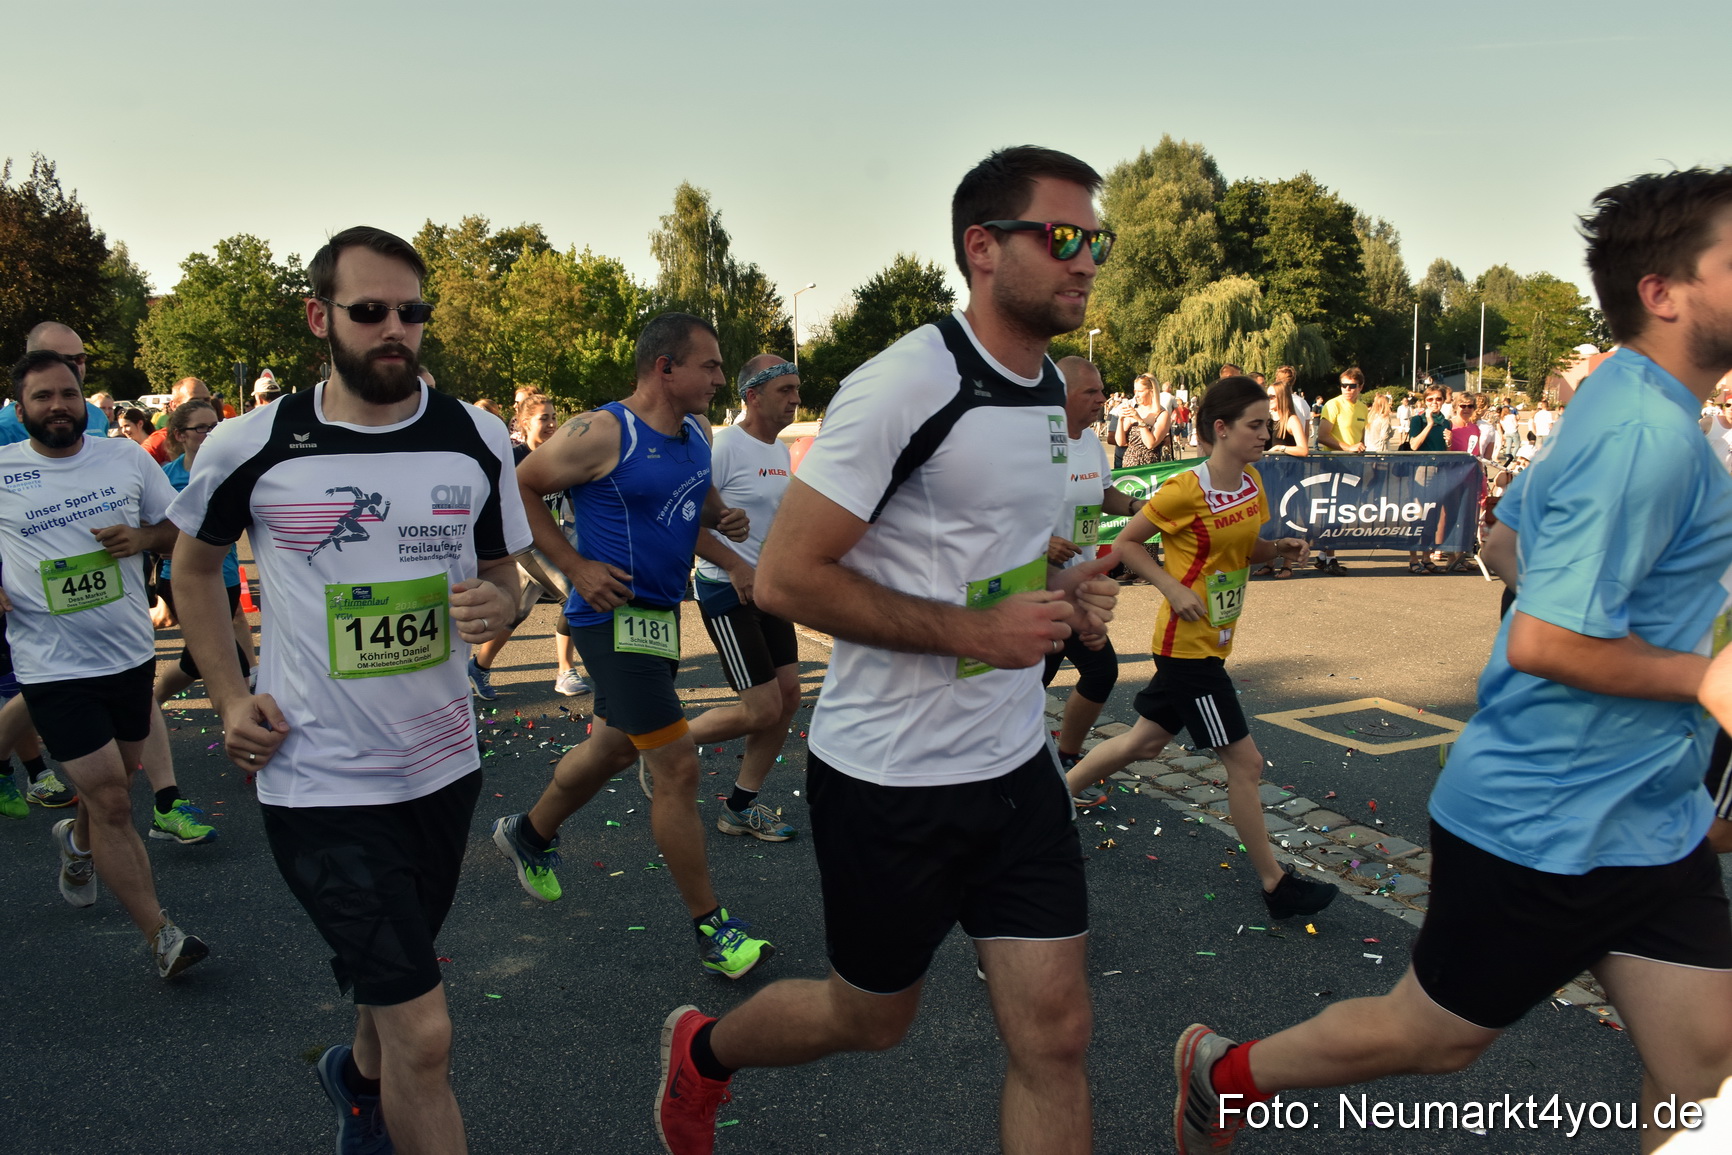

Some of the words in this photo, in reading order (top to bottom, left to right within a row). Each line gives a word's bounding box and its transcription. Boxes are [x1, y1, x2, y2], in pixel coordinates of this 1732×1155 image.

[4, 470, 41, 484] DESS
[25, 503, 61, 520] Unser
[64, 491, 98, 508] Sport
[100, 486, 116, 498] ist
[431, 484, 472, 504] OM
[656, 497, 673, 521] Team
[672, 476, 696, 498] Schick
[20, 496, 130, 538] SchüttguttranSport
[1098, 517, 1129, 528] sund
[1214, 510, 1245, 530] MAX
[1246, 501, 1260, 517] BÖ
[1309, 496, 1437, 524] Fischer
[398, 524, 467, 538] VORSICHT!
[1318, 526, 1425, 539] AUTOMOBILE
[62, 570, 107, 597] 448
[1216, 585, 1246, 610] 121
[345, 608, 439, 651] 1464
[624, 616, 669, 643] 1181
[356, 659, 413, 669] OM-Klebetechnik
[413, 653, 432, 663] GmbH
[360, 650, 400, 662] Köhring
[402, 644, 430, 657] Daniel
